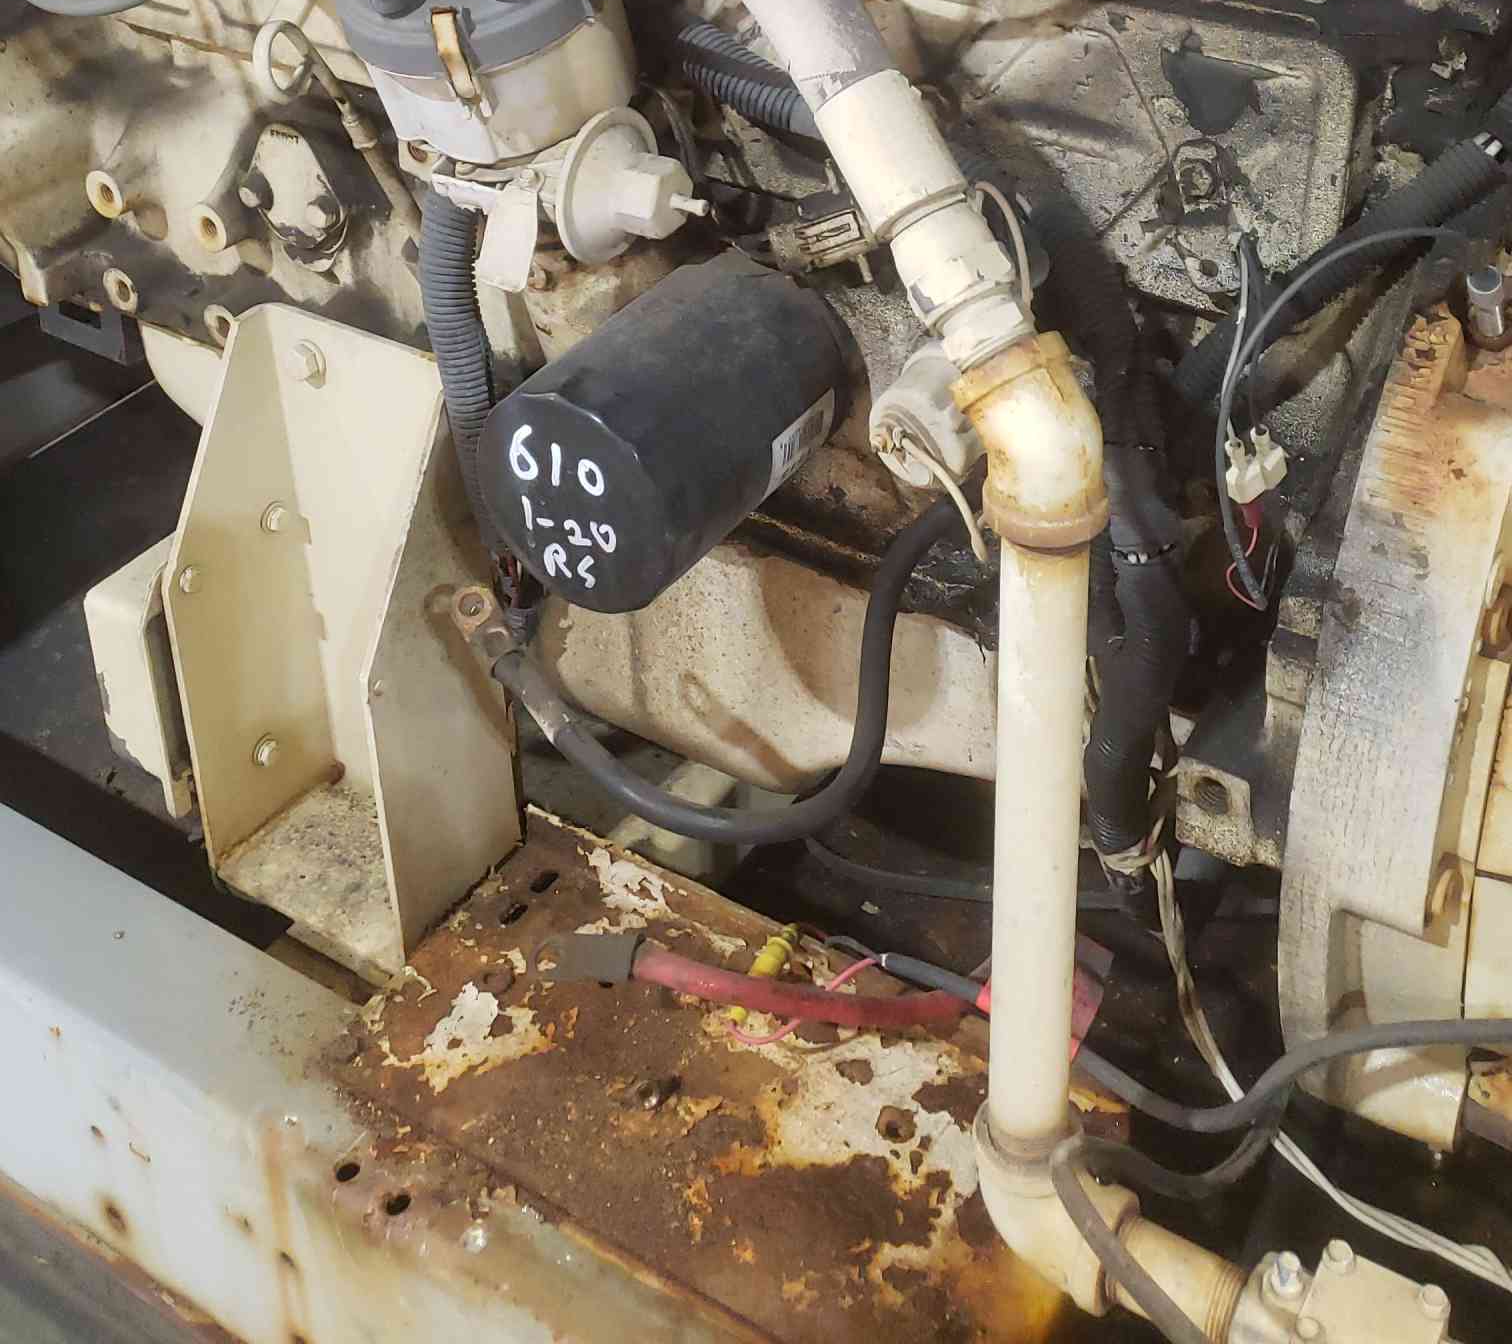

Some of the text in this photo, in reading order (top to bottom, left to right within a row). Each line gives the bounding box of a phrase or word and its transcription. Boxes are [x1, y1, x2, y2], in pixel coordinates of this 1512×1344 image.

[509, 424, 604, 496] 610
[521, 495, 617, 553] 1-20
[543, 543, 596, 589] RS
